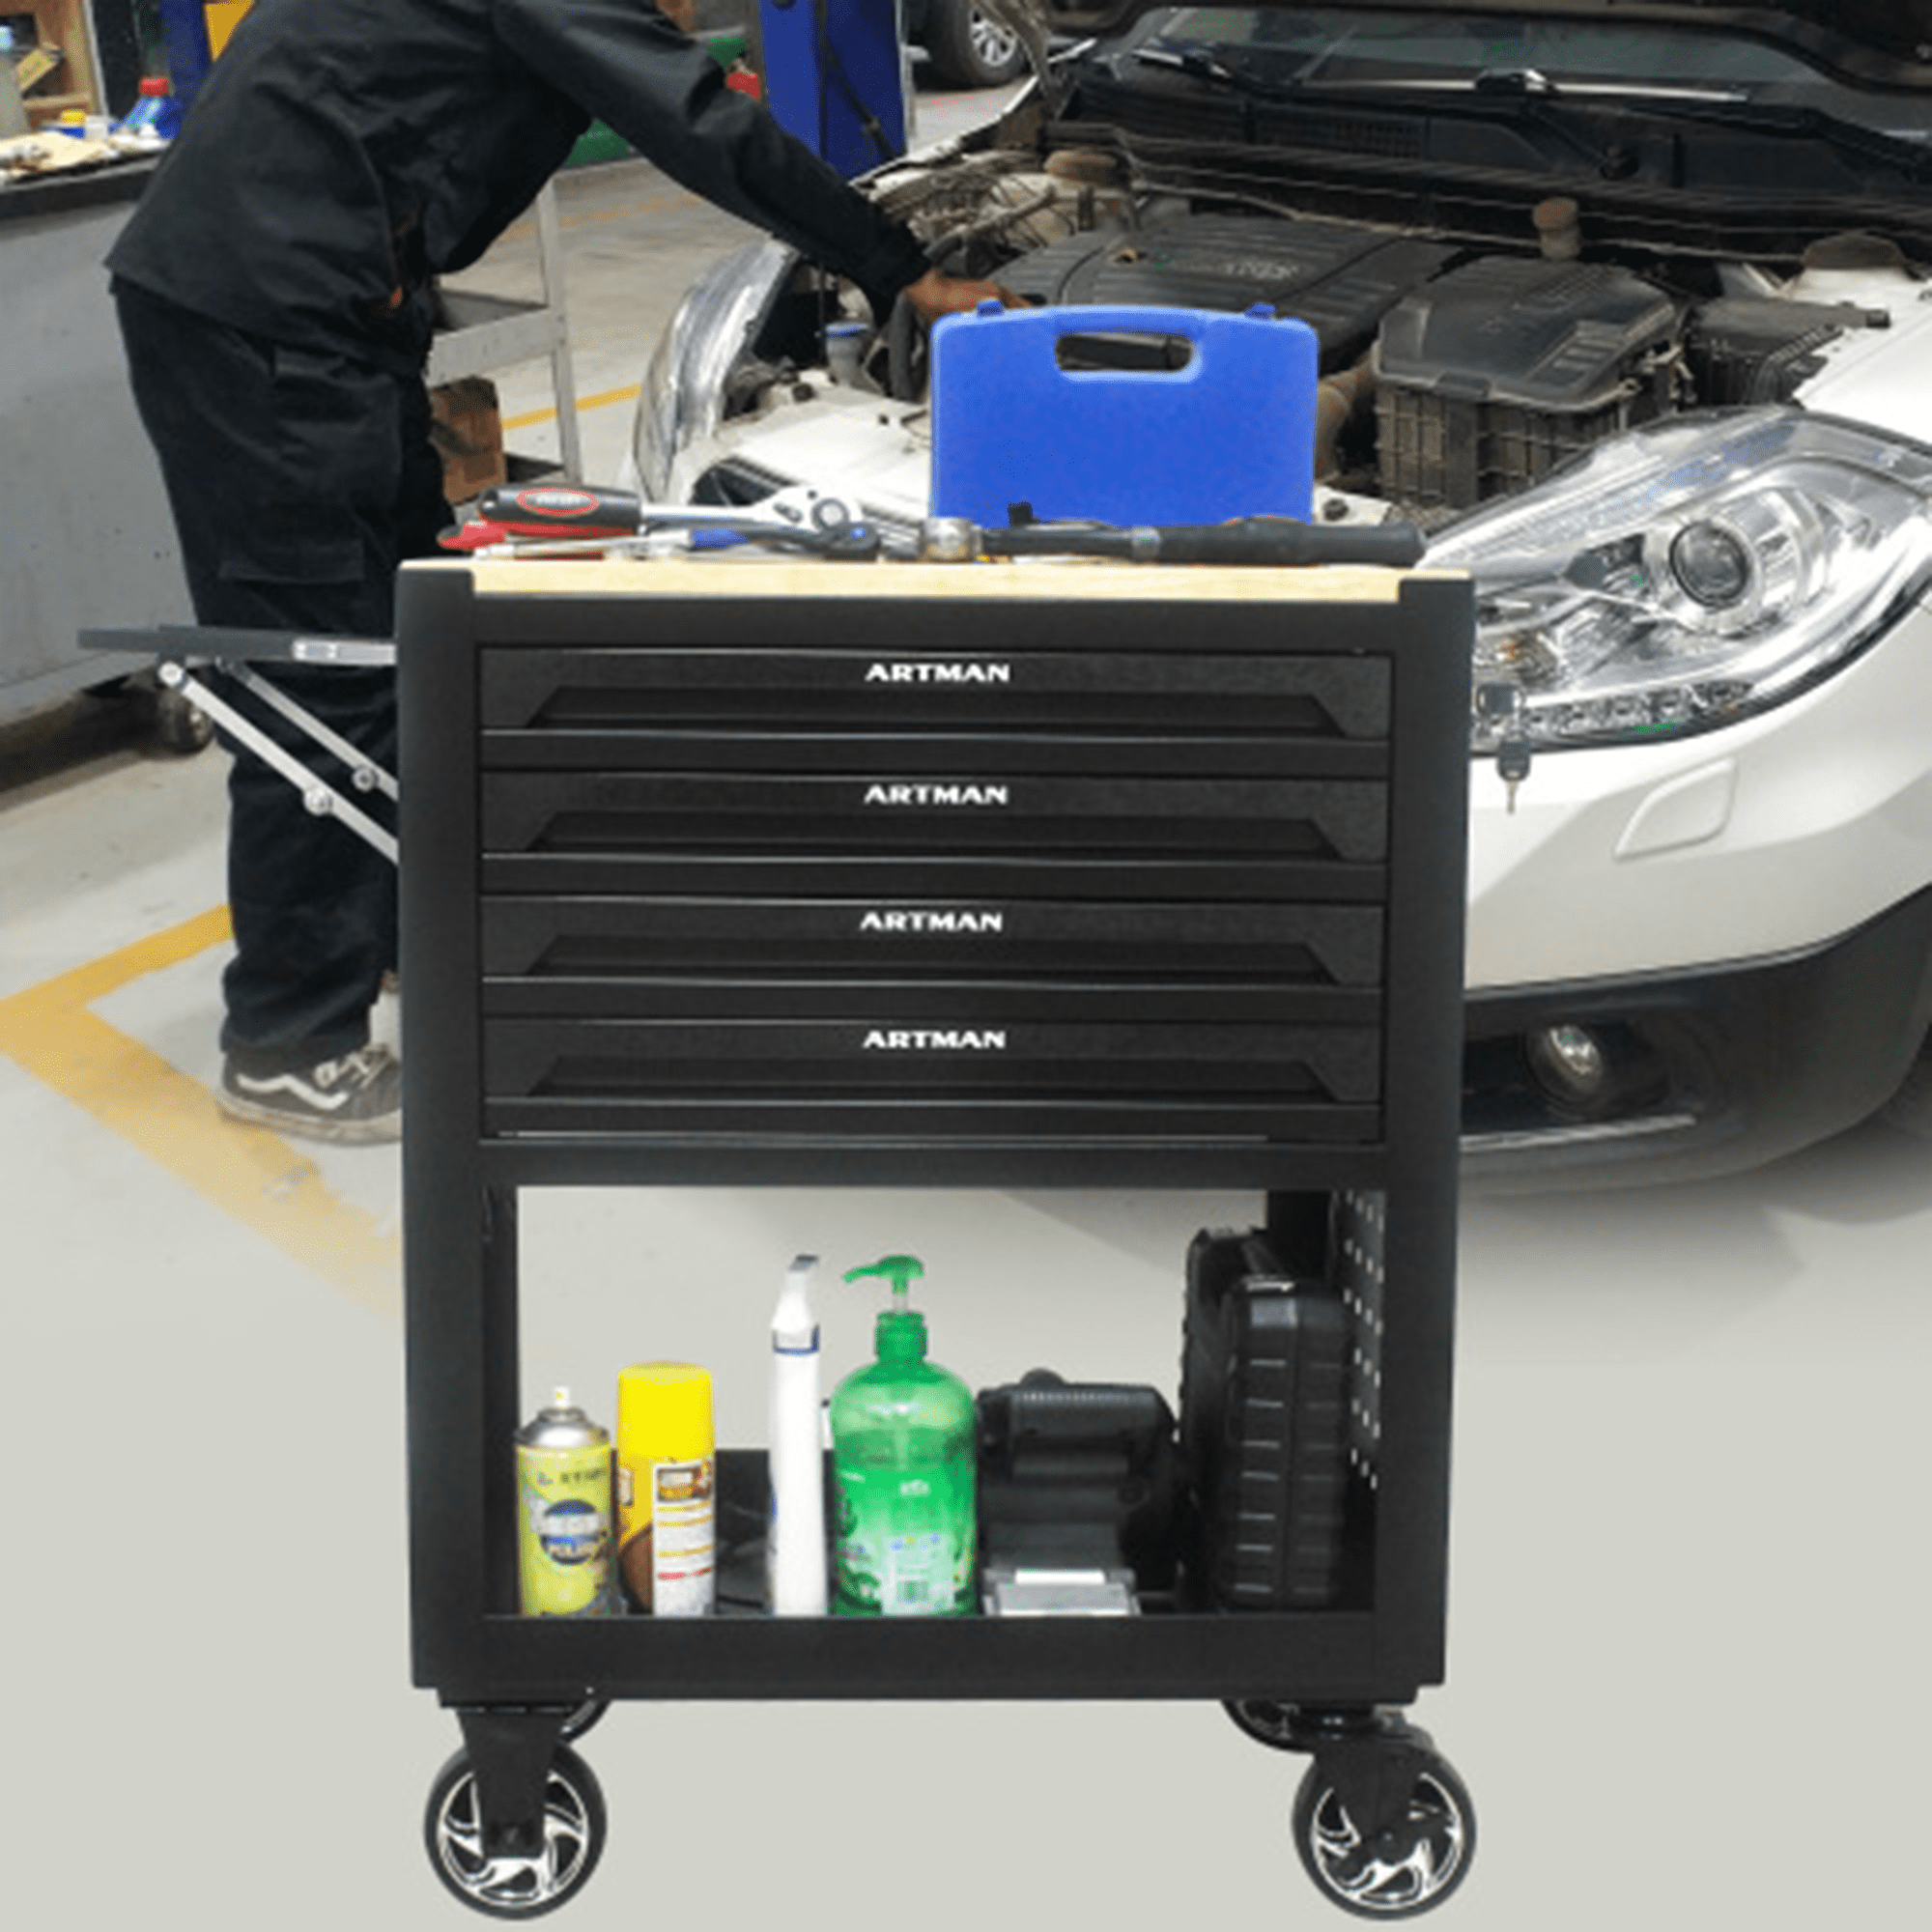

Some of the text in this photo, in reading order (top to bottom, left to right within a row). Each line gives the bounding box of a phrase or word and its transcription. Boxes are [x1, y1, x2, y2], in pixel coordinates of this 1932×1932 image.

[865, 663, 1010, 682] ARTMAN
[864, 784, 1009, 805] ARTMAN
[860, 911, 1003, 931] ARTMAN
[862, 1030, 1007, 1049] ARTMAN
